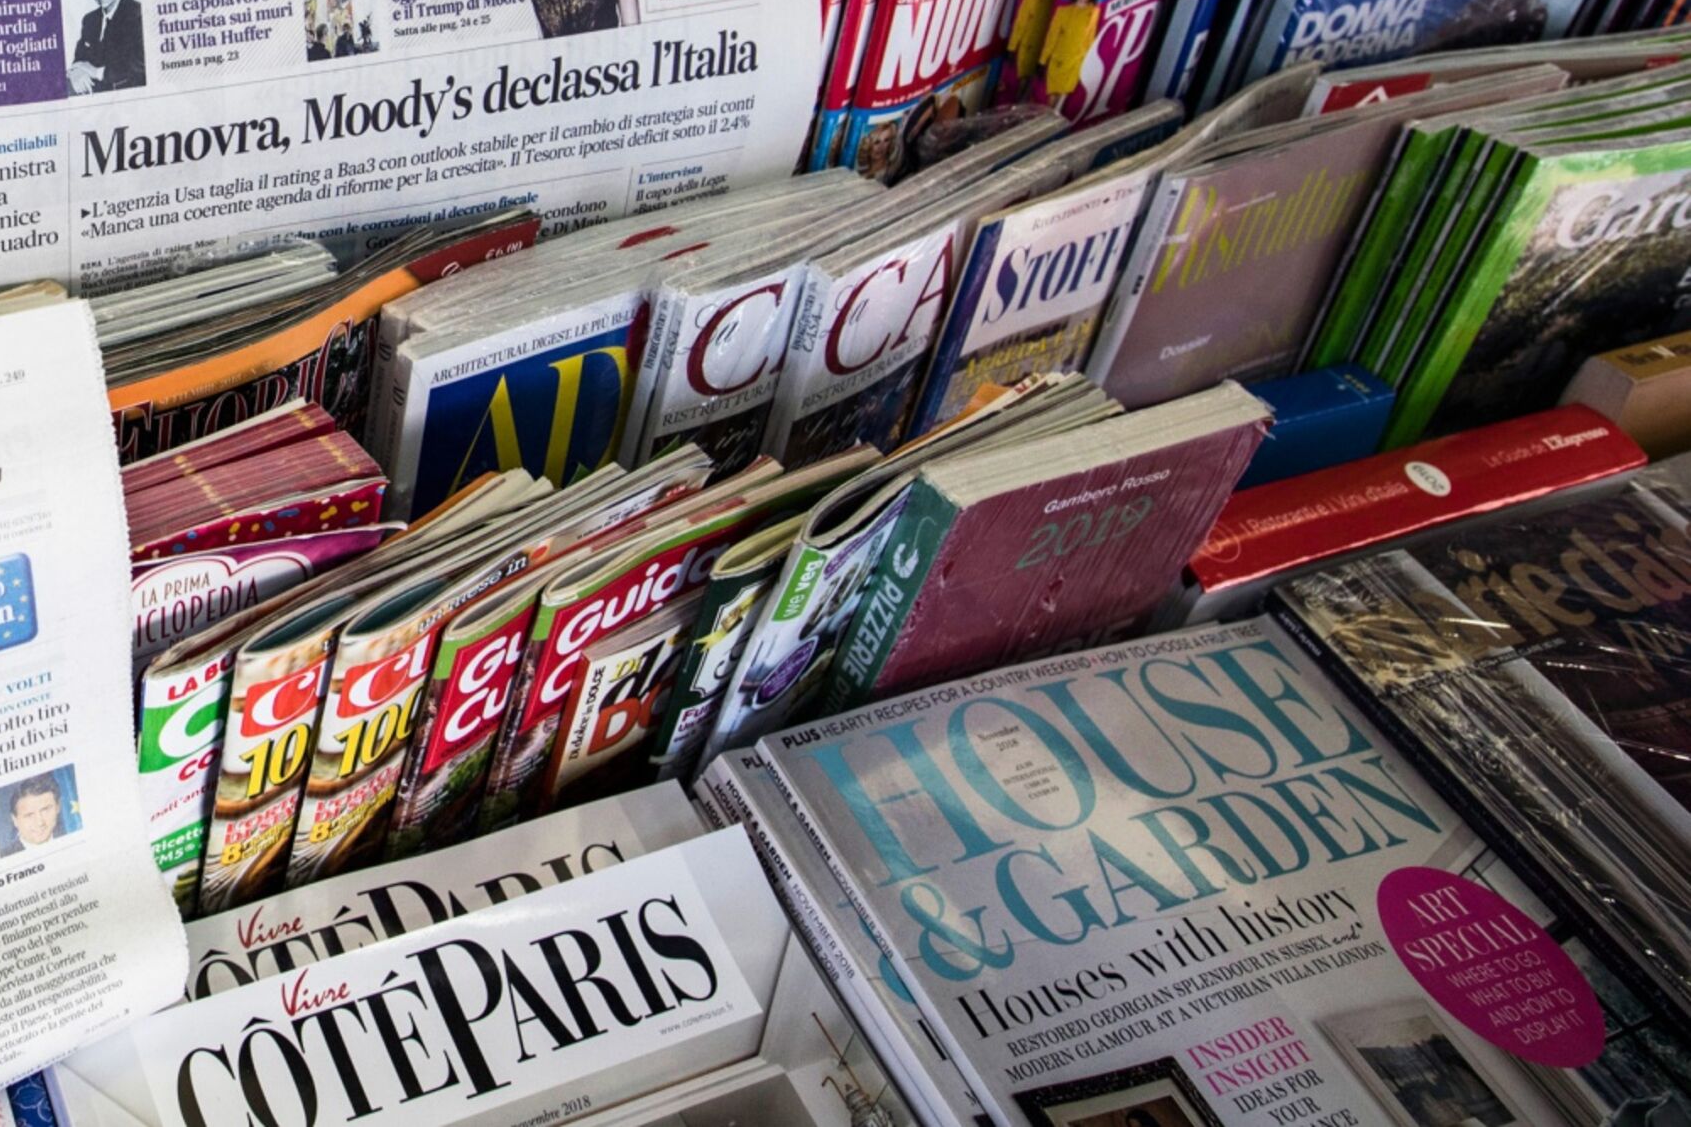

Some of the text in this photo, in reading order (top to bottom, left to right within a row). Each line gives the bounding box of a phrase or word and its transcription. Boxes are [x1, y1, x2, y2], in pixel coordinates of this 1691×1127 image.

[159, 13, 227, 35] futurista
[82, 110, 291, 178] Manovra,
[483, 56, 640, 116] declassa
[431, 340, 529, 383] ARCHITECTURAL
[1043, 468, 1172, 515] Gambero Rosso
[1014, 498, 1151, 570] 2019
[164, 573, 210, 598] PRIMA
[781, 696, 930, 749] PLUS HEARTY RECIPES
[812, 640, 1373, 887] HOUSE
[238, 906, 302, 948] Vivre
[1407, 886, 1469, 927] ART
[955, 887, 1360, 1039] Houses with history
[1404, 915, 1538, 971] SPECIAL
[281, 969, 350, 1015] Vivre
[1007, 988, 1170, 1057] RESTORED GEORGIAN
[1185, 1015, 1294, 1070] INSIDER
[1202, 1040, 1313, 1096] INSIGHT
